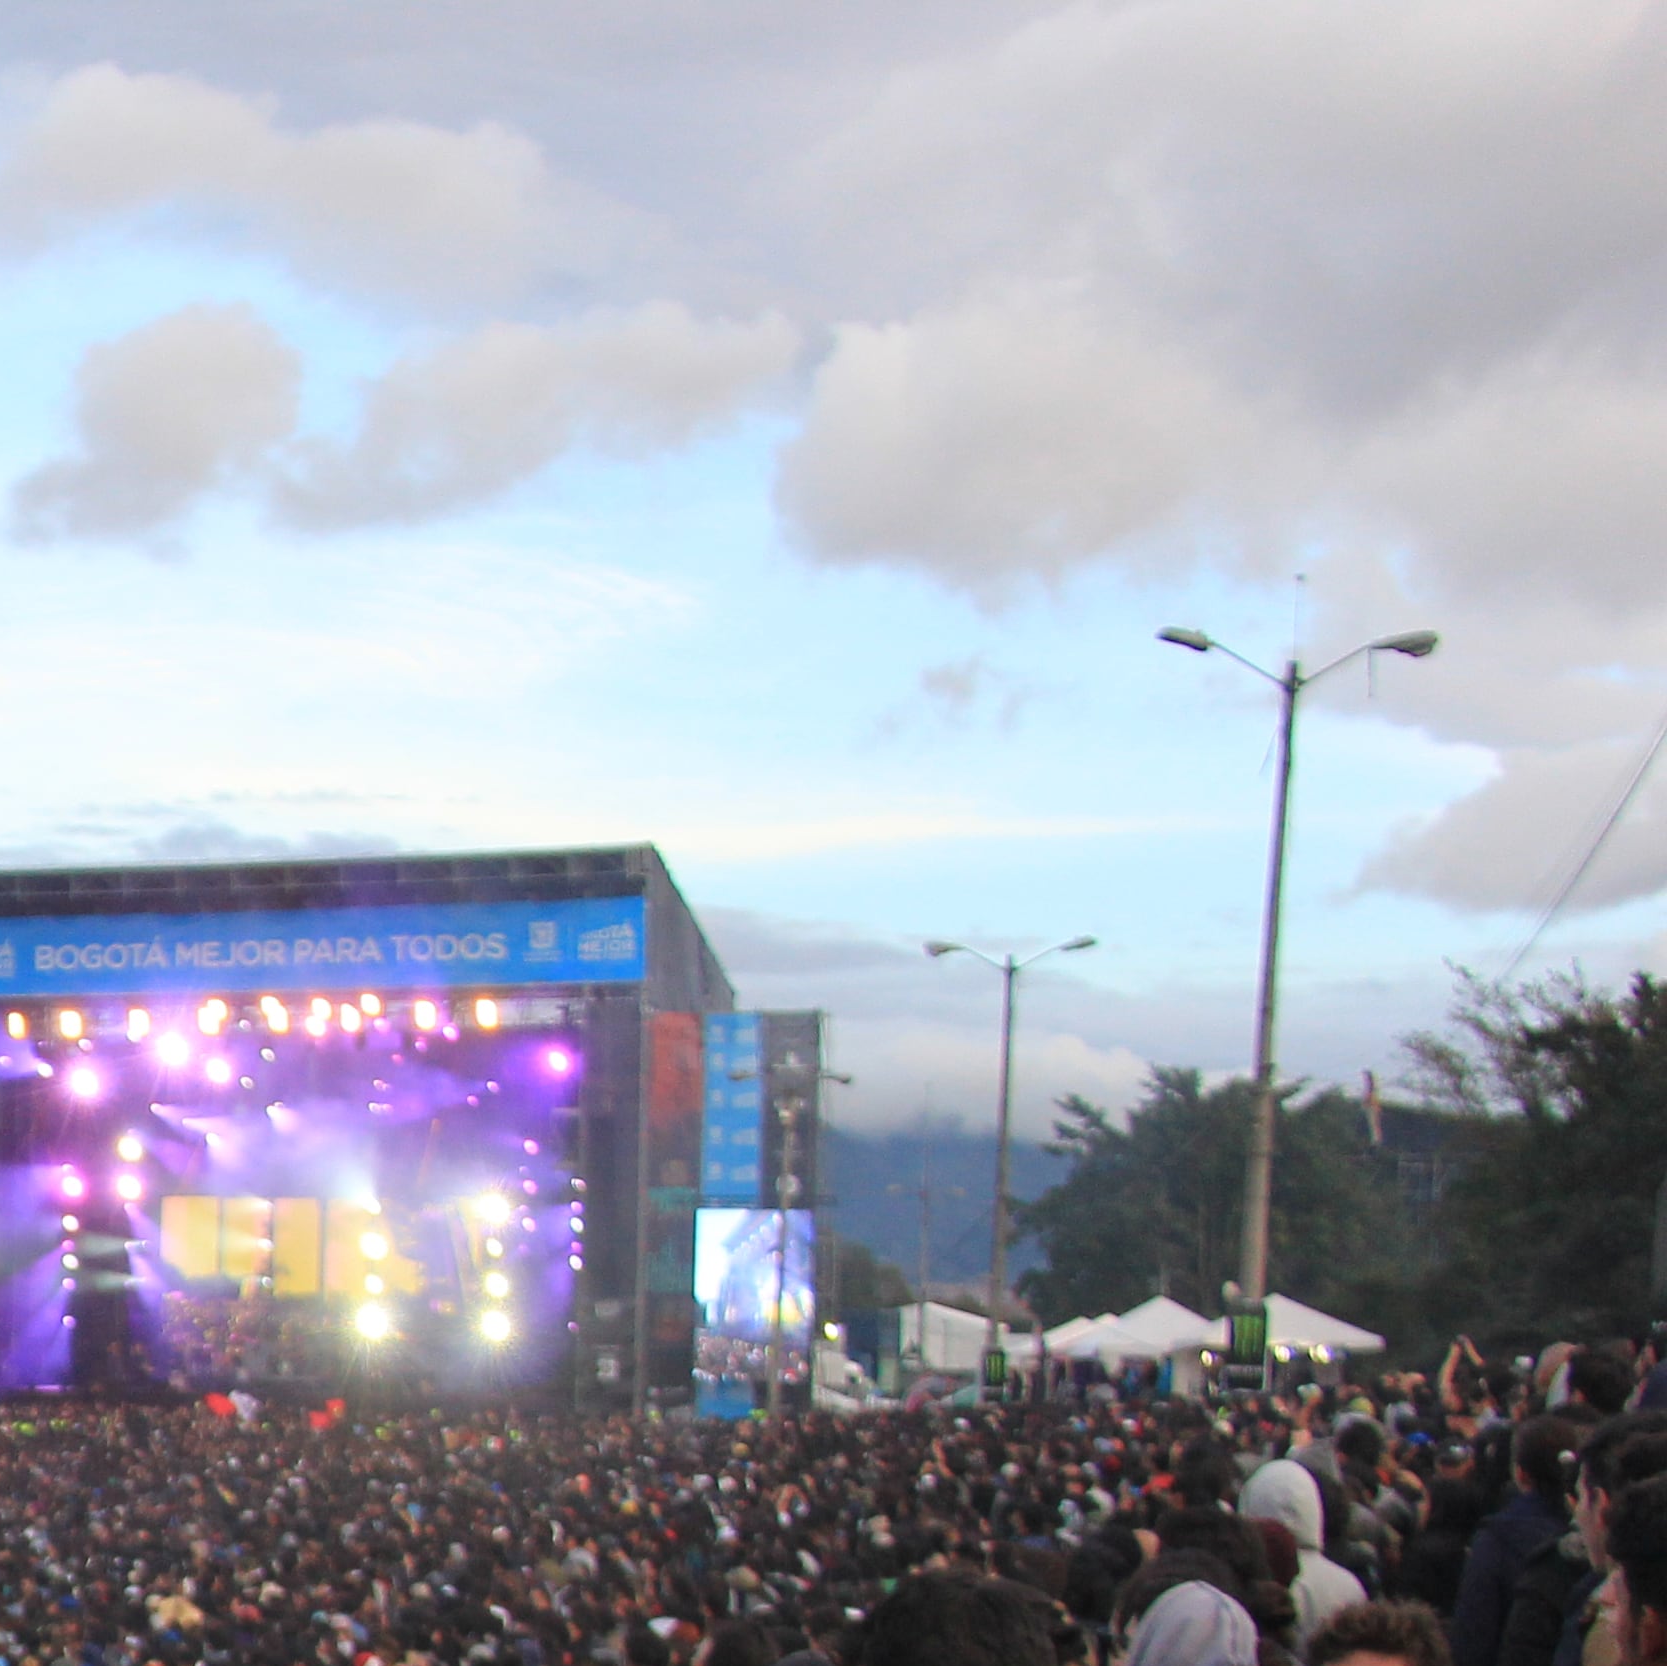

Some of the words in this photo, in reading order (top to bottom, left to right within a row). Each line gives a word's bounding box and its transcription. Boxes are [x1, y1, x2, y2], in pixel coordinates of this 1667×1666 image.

[34, 935, 166, 970] BOGOTÁ
[175, 939, 285, 968] MEJOR
[294, 936, 385, 963] PARA
[390, 932, 508, 961] TODOS
